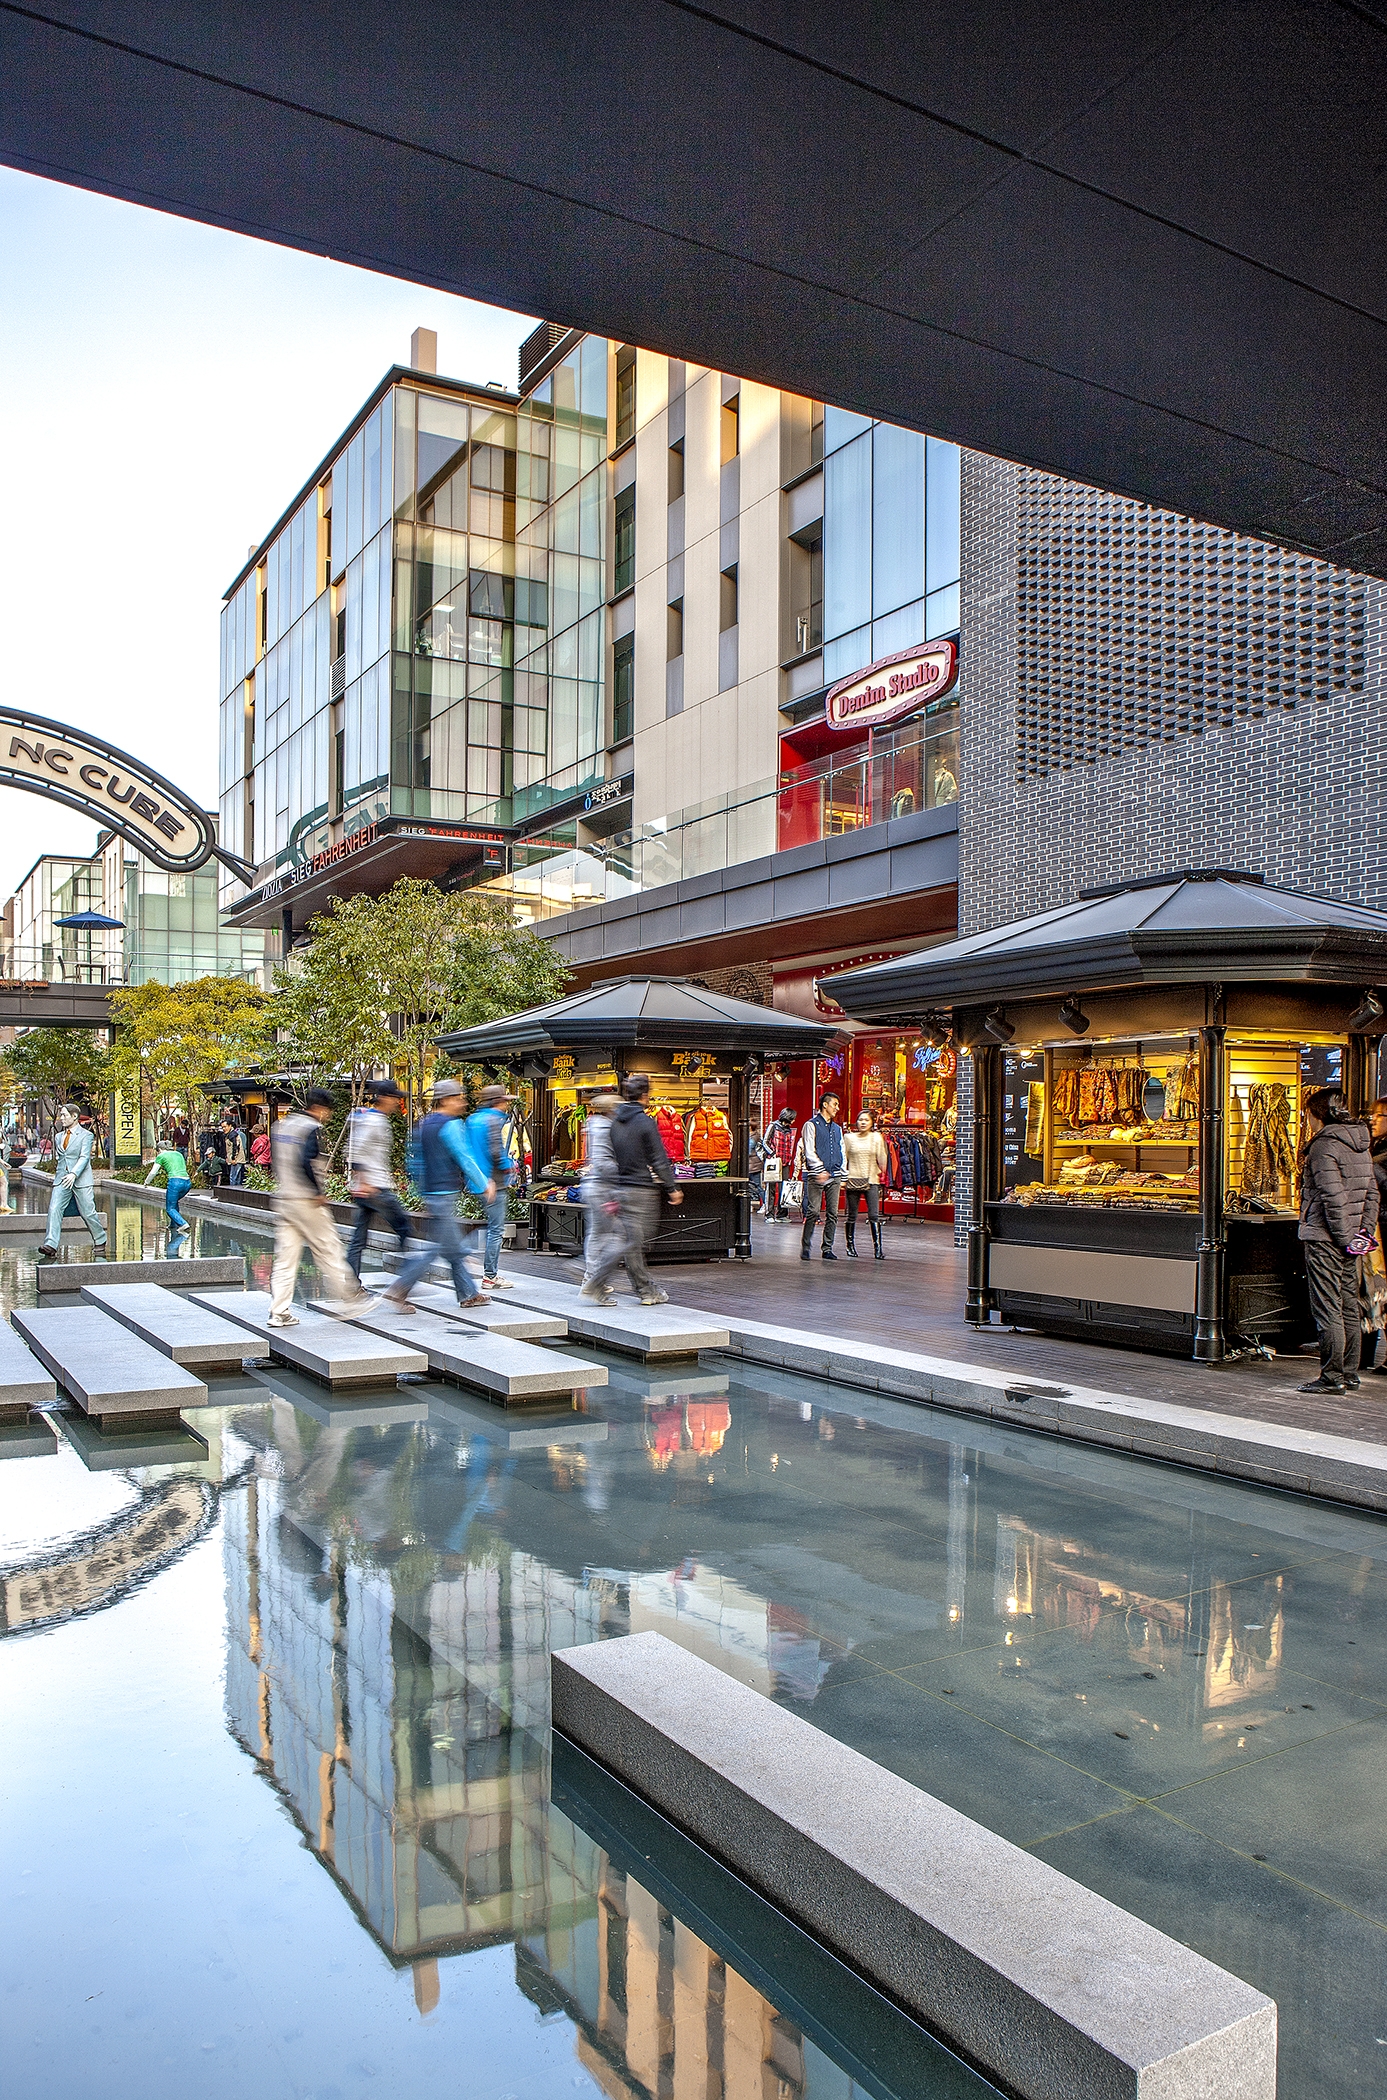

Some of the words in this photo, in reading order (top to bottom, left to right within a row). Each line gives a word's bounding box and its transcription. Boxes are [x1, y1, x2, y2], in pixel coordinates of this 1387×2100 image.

[838, 685, 886, 718] Denim
[888, 661, 939, 698] Studio
[8, 736, 74, 774] NC
[79, 764, 186, 841] CUBE
[400, 826, 426, 835] SIEG
[290, 860, 313, 885] SIEG
[552, 1056, 575, 1069] Bank
[121, 1102, 134, 1139] OPEN
